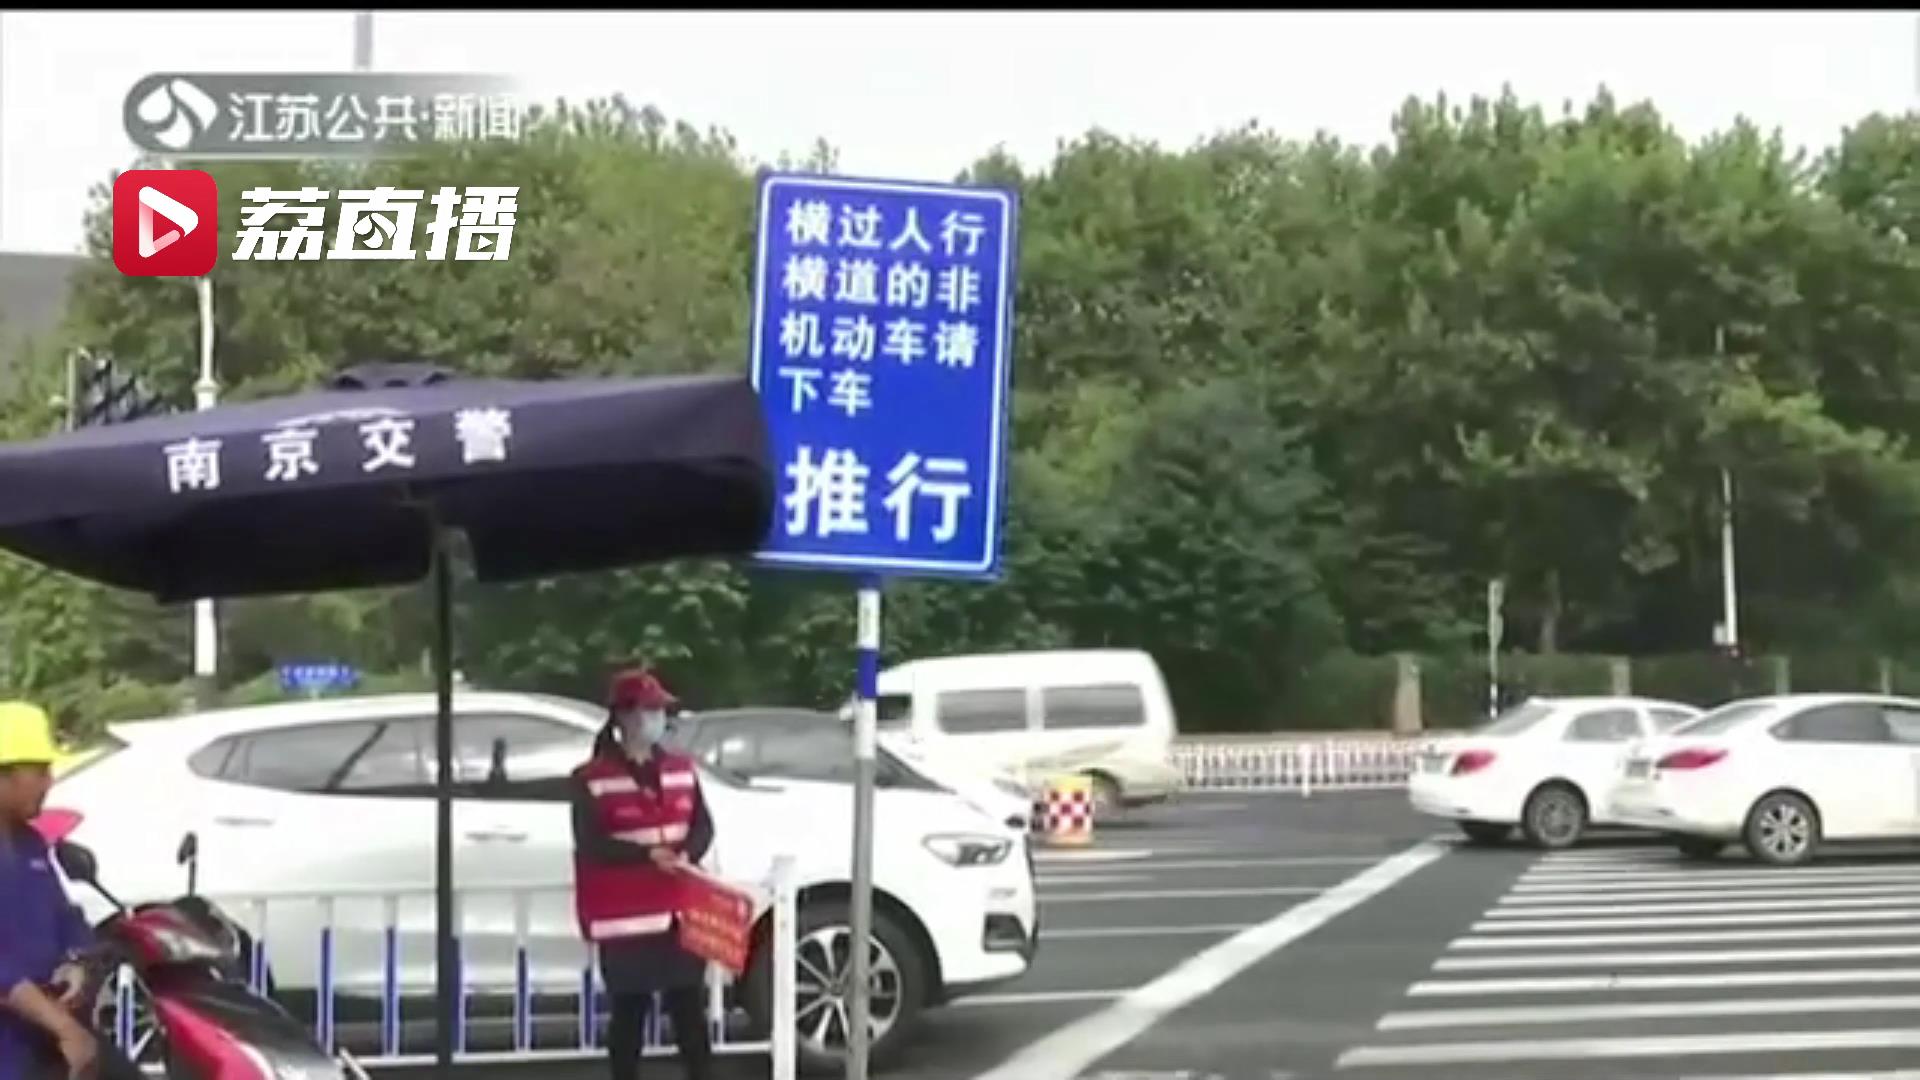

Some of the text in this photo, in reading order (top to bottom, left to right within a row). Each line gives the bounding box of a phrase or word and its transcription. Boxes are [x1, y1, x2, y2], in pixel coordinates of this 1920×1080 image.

[786, 199, 986, 257] 横过人行
[783, 254, 981, 314] 横道的非
[779, 311, 979, 369] 机动车请
[779, 366, 873, 417] 下车
[163, 408, 512, 493] 南京交警
[784, 444, 972, 543] 推行
